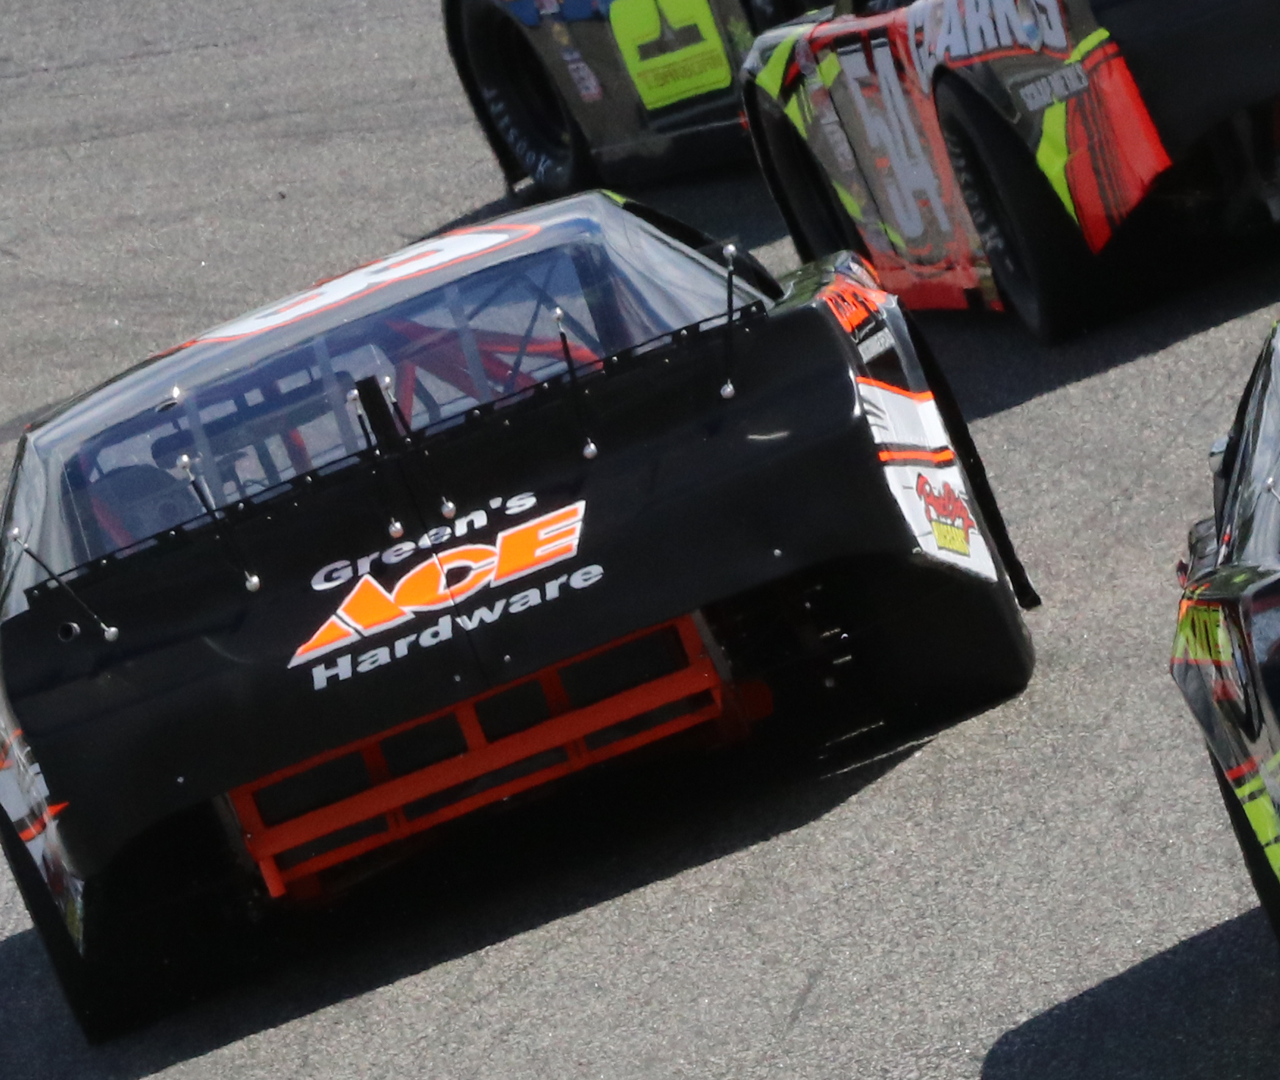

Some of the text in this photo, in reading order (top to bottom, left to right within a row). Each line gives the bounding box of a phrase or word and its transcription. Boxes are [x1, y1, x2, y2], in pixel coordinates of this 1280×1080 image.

[836, 36, 953, 240] 54
[287, 500, 586, 670] ACE
[310, 491, 538, 592] Green's
[311, 564, 605, 692] Hardware
